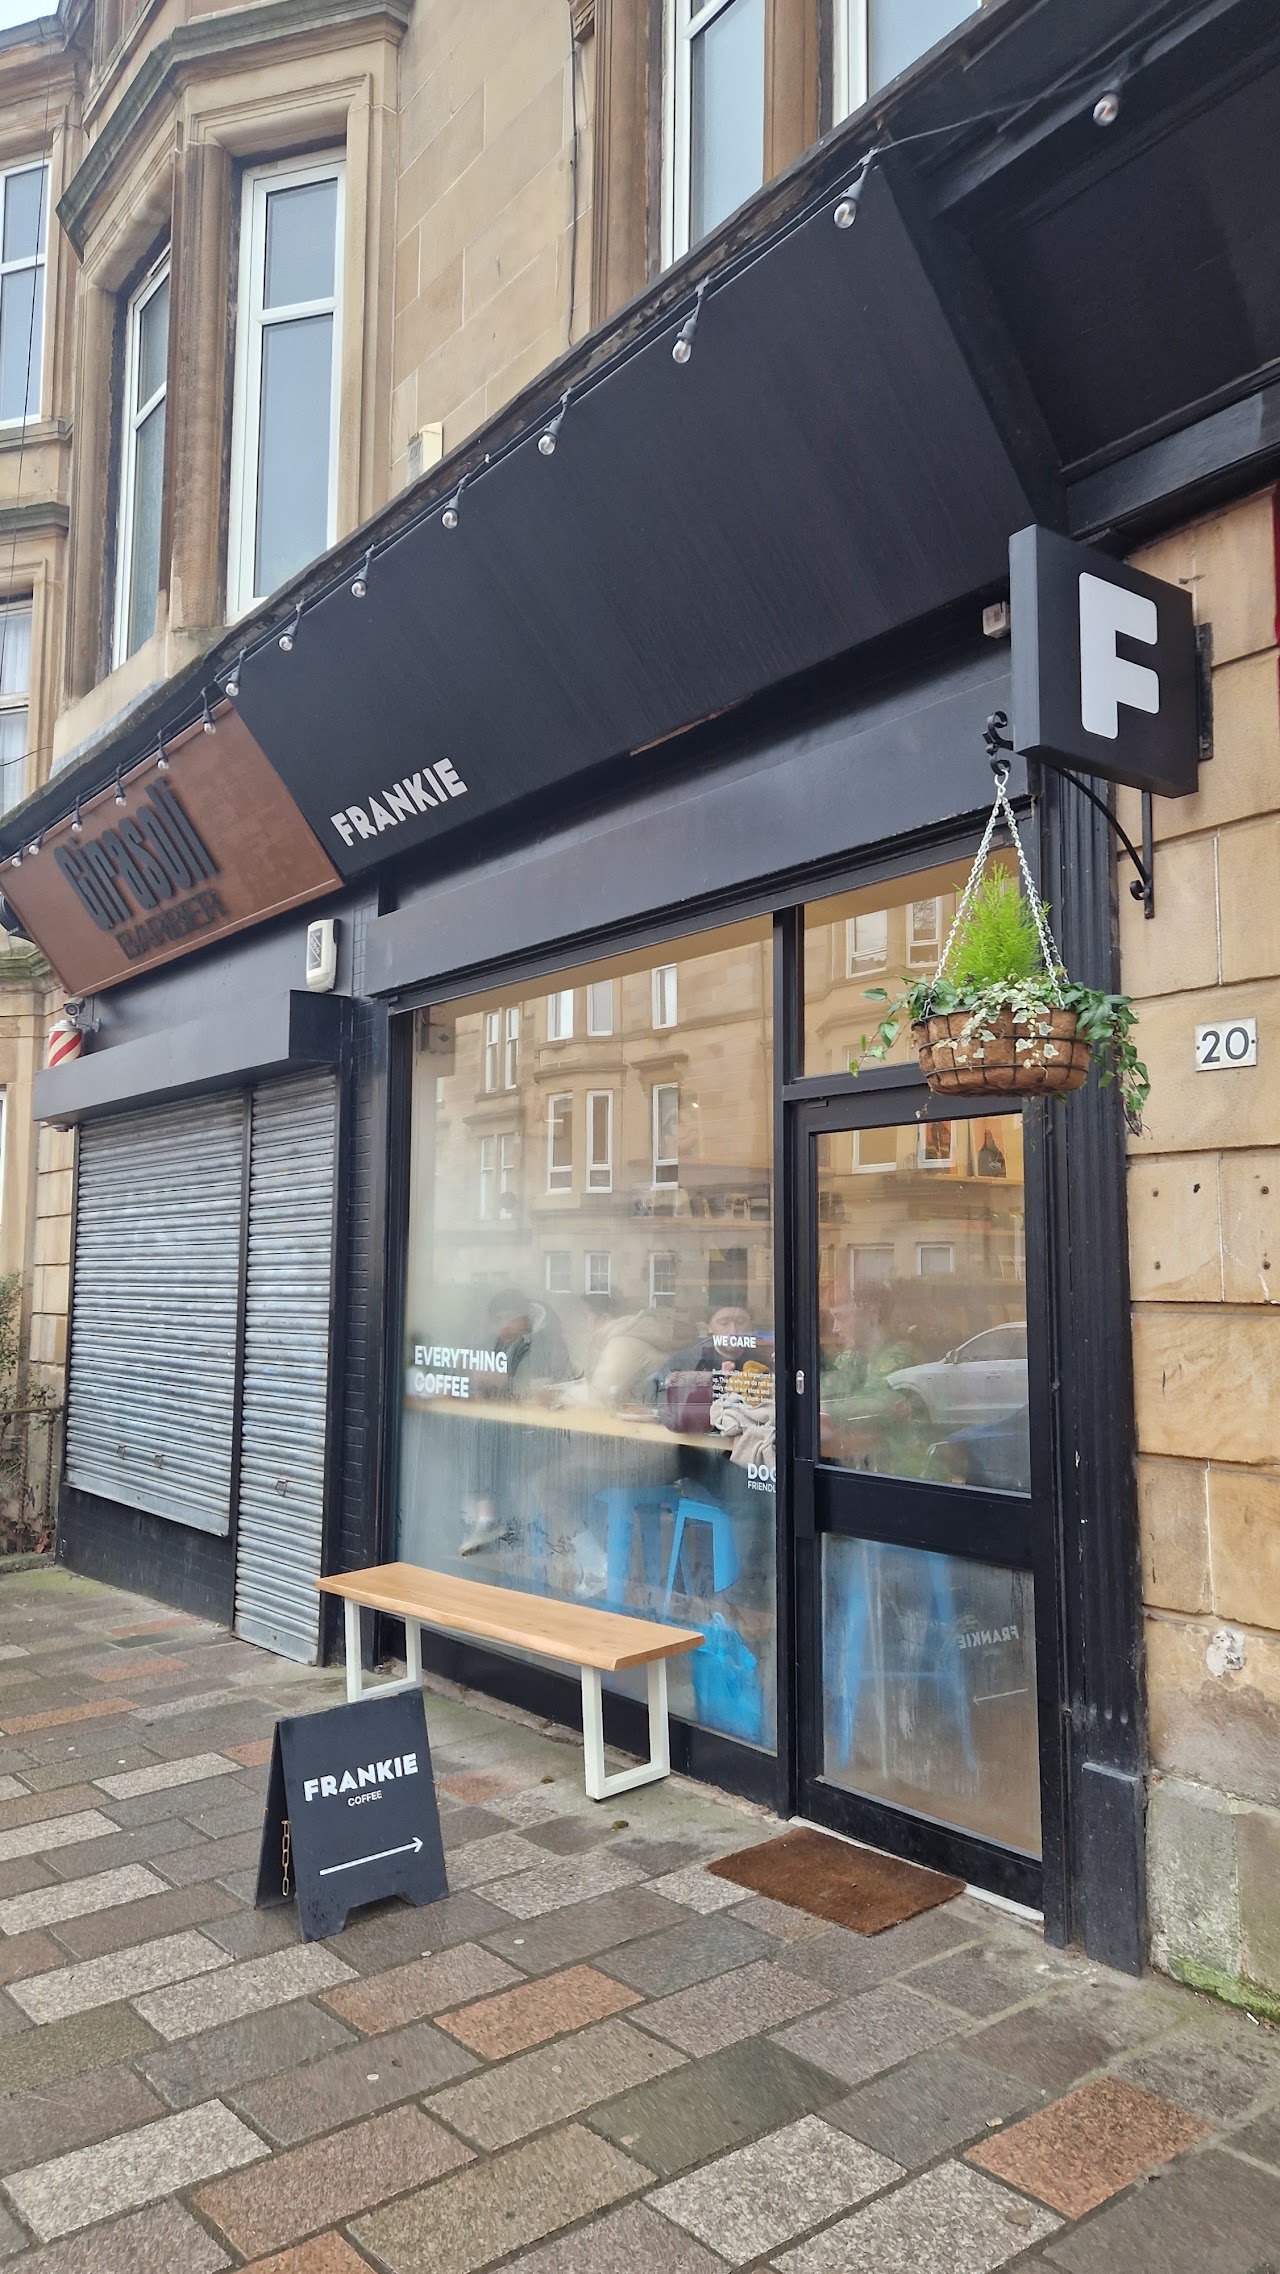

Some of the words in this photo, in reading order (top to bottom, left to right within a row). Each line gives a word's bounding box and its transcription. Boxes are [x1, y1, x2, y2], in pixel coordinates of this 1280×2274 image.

[1079, 572, 1160, 740] F
[330, 757, 468, 847] FRANKIE
[115, 887, 228, 960] BARBER
[1201, 1026, 1250, 1064] 20
[712, 1334, 729, 1347] WE
[729, 1335, 757, 1349] CARE
[414, 1345, 508, 1374] EVERYTHING
[414, 1372, 470, 1398] COFFEE
[747, 1480, 777, 1494] FRIENDL
[303, 1752, 419, 1802] FRANKIE
[347, 1789, 383, 1807] COFFEE
